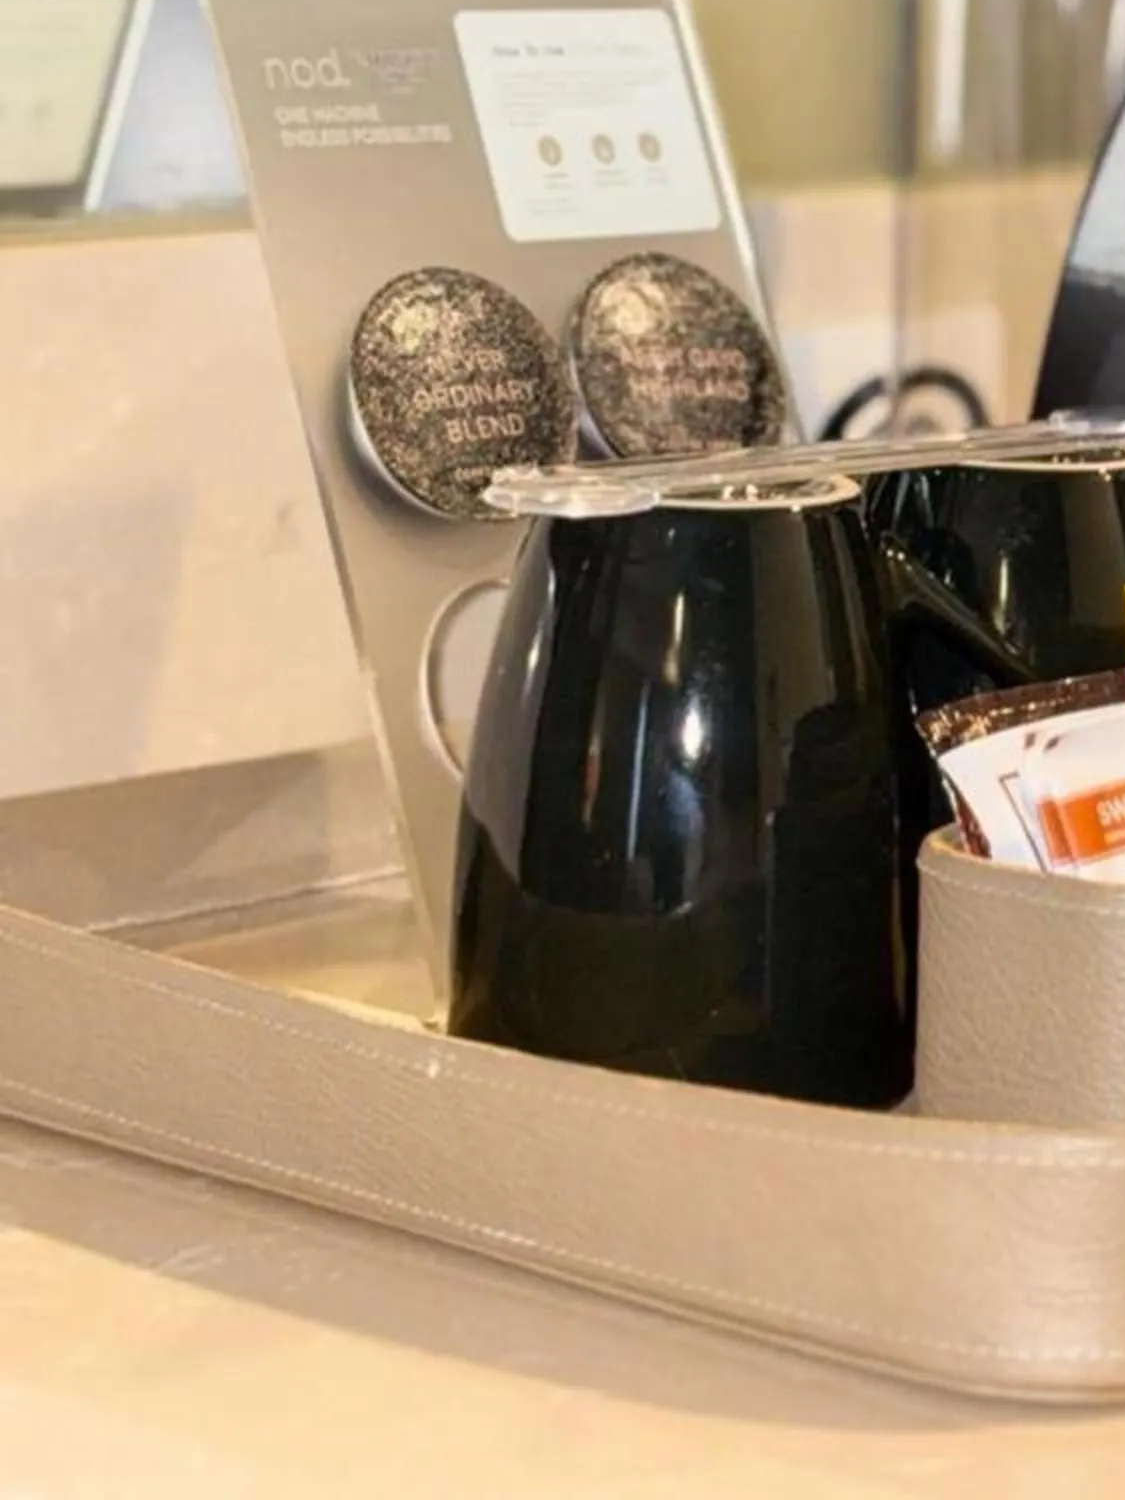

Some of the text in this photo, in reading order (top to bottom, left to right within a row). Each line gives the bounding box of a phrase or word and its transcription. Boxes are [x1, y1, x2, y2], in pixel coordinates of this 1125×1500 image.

[273, 102, 382, 126] ONE MACHINE
[280, 126, 350, 148] ENDLESS
[427, 347, 507, 374] NEVER
[412, 377, 540, 412] ORDINARY
[445, 411, 525, 444] BLEND
